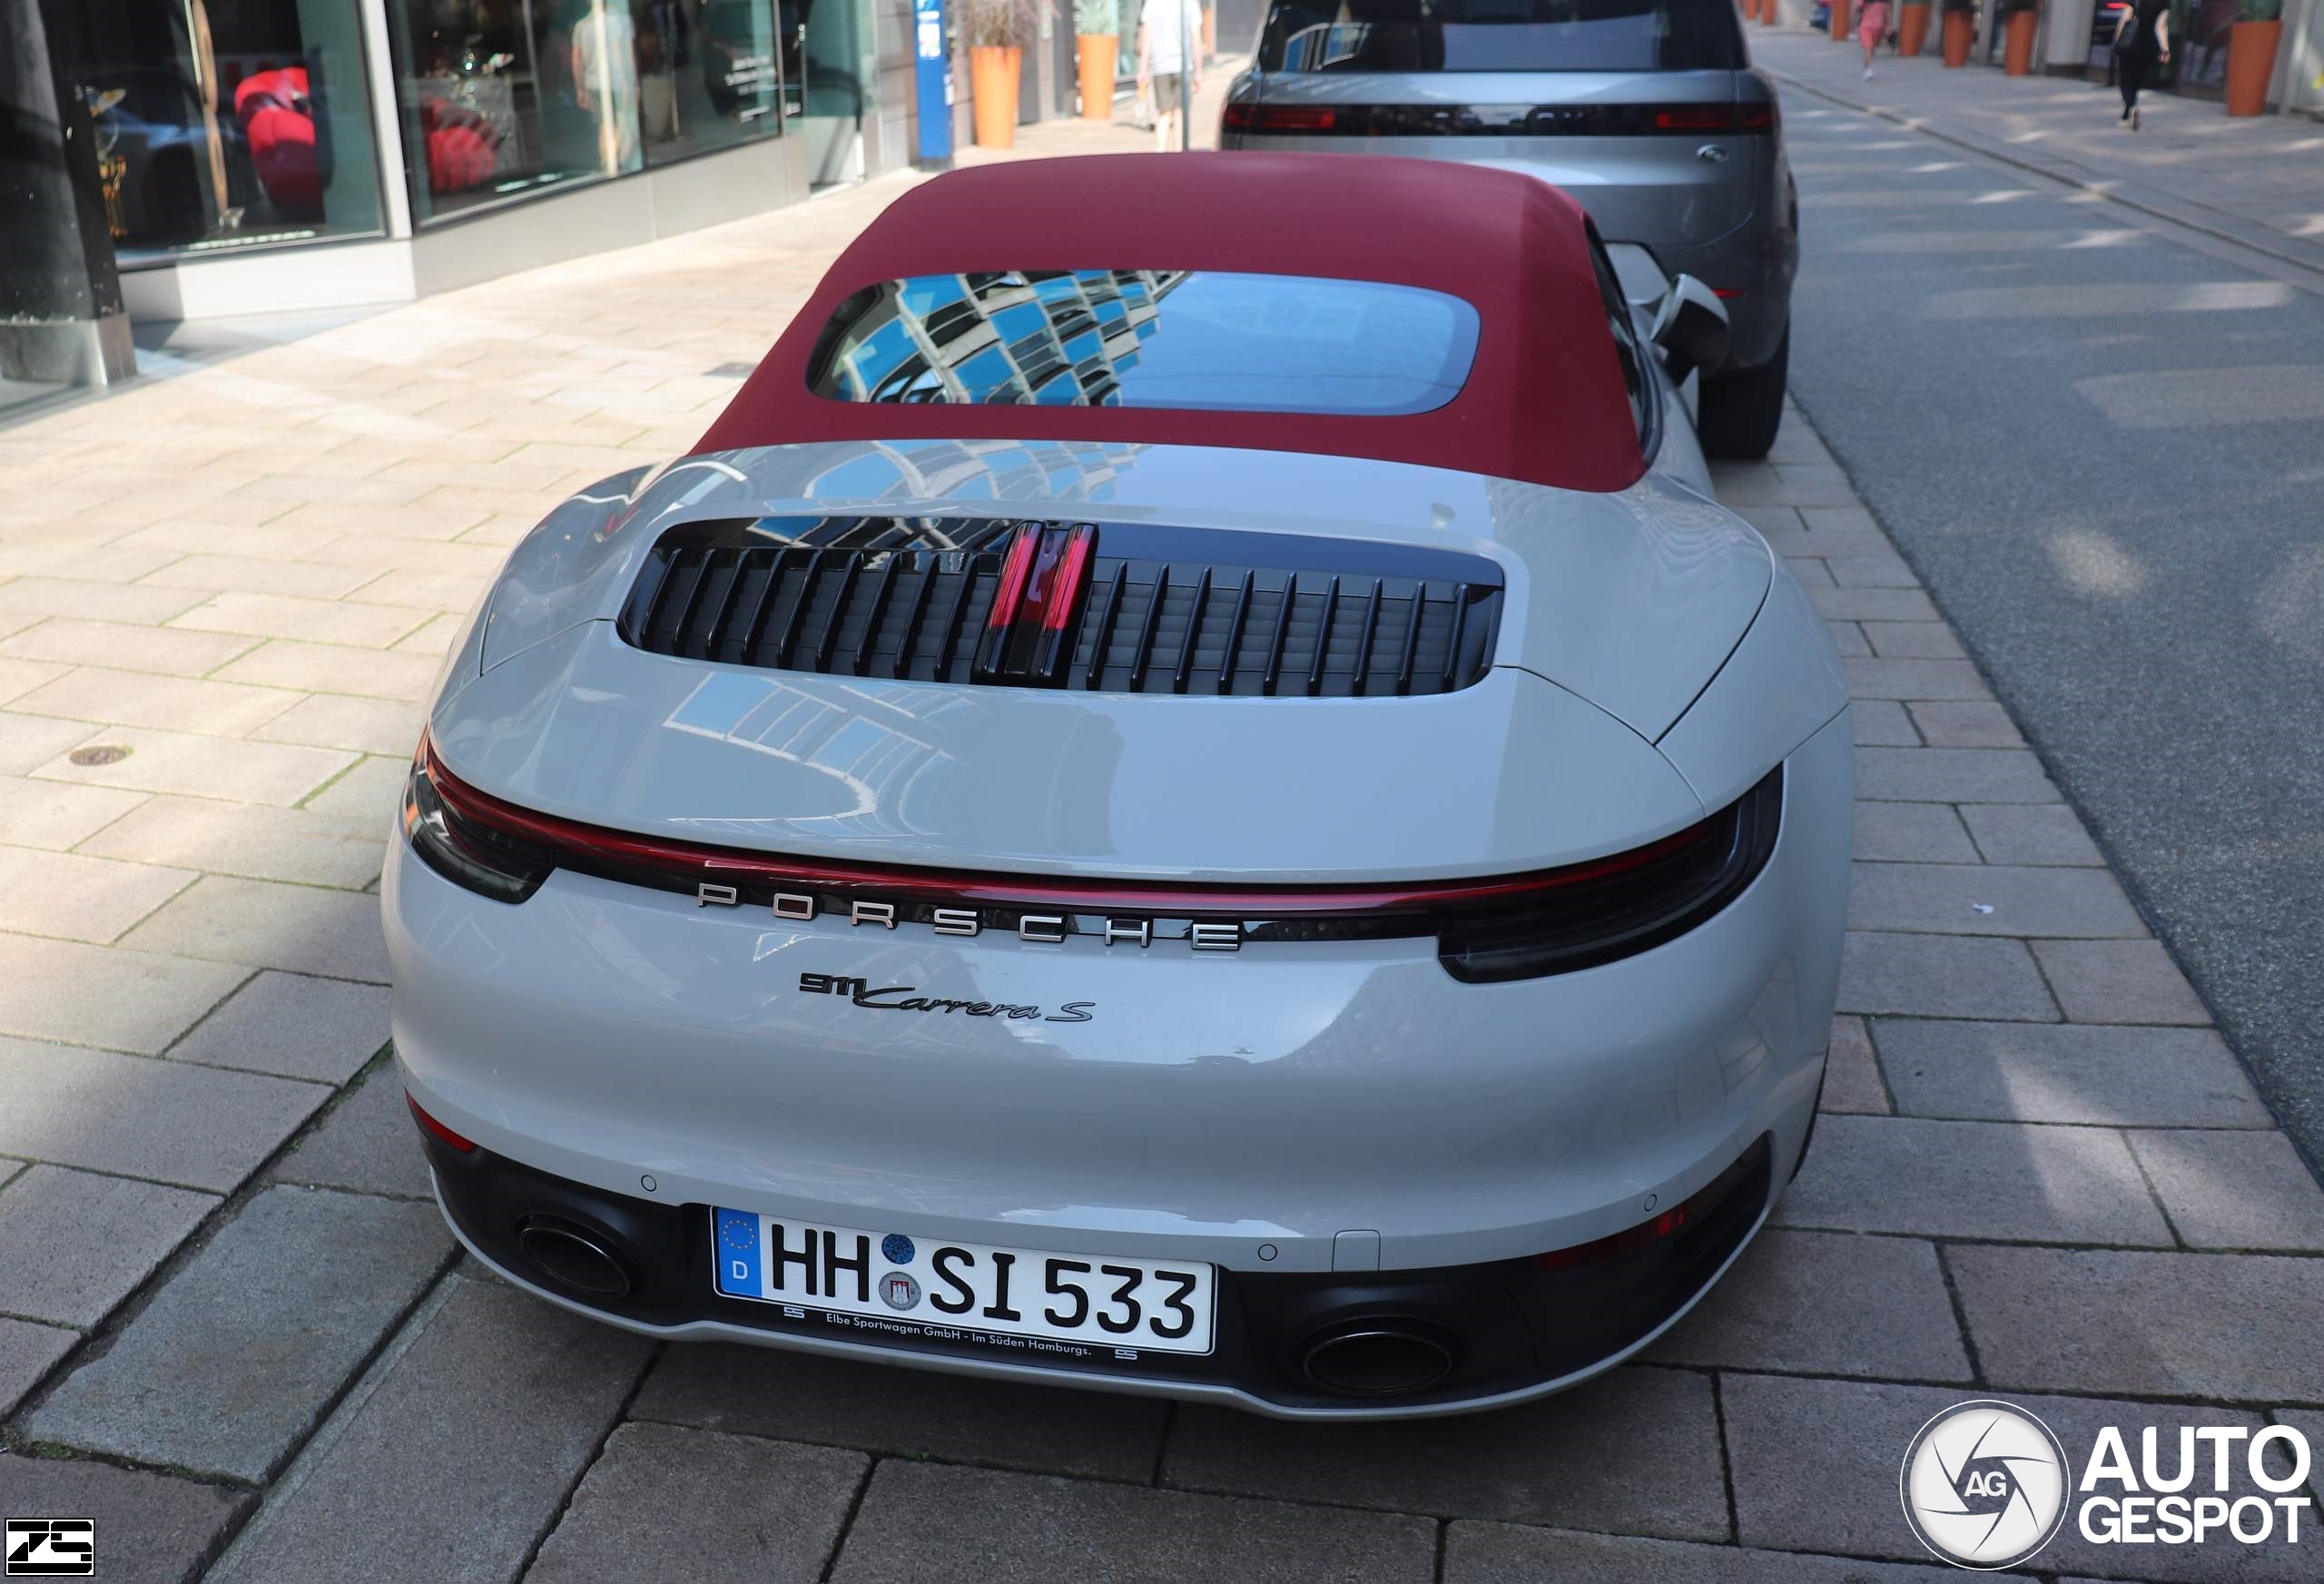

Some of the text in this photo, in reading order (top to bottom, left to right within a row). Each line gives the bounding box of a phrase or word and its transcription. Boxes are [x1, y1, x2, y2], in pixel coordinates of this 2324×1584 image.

[698, 883, 1239, 950] PORSCHE
[800, 973, 1096, 1022] 911 Carrera S
[733, 1260, 748, 1280] D
[772, 1224, 1196, 1339] HH SI 533
[826, 1313, 851, 1325] Elbe
[853, 1316, 921, 1334] Sportwagen
[924, 1326, 960, 1340] GmbH
[972, 1333, 986, 1343] Im
[990, 1334, 1025, 1348] Süden
[1029, 1340, 1092, 1356] Hamburgs.
